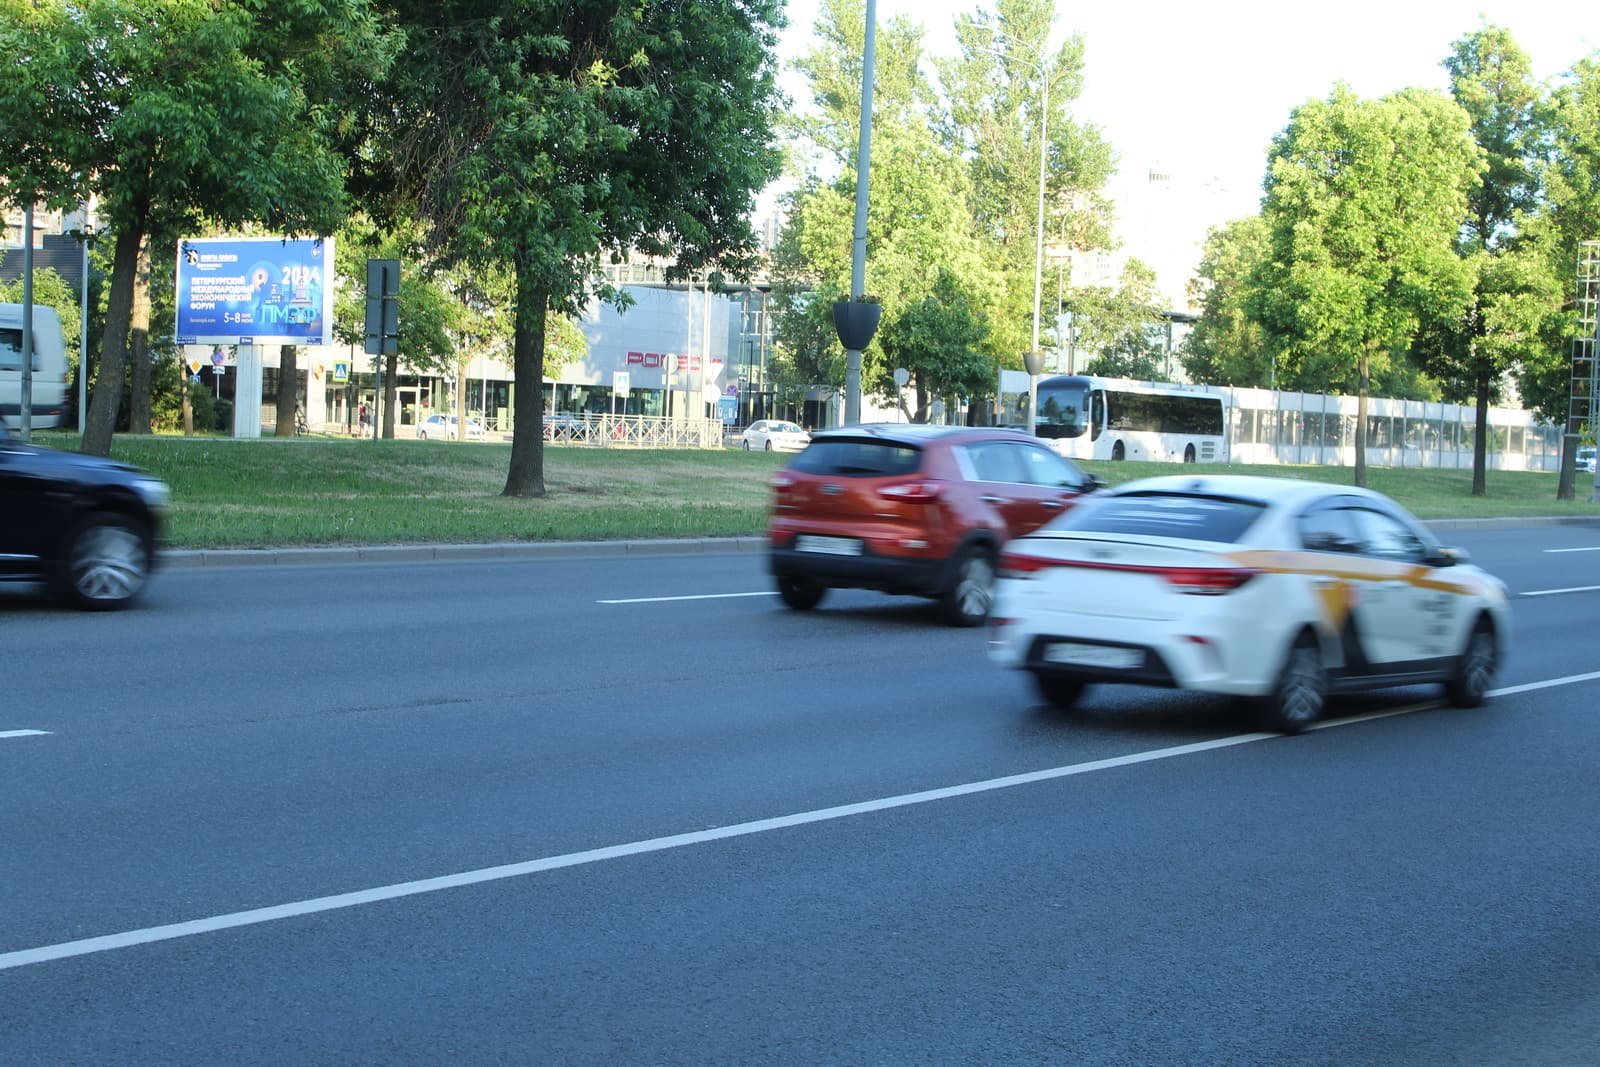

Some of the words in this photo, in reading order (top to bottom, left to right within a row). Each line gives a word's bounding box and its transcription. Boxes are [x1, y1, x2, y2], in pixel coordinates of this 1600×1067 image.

[191, 275, 246, 286] ПЕТЕРБУРГСКИЙ
[281, 266, 320, 285] 2024
[191, 284, 255, 294] МЕЖДУНАРОДНЫЙ
[190, 293, 252, 302] ЭКОНОМИЧЕСКИЙ
[190, 302, 215, 310] ФОРУМ
[262, 304, 317, 324] ПМЭФ
[626, 351, 722, 371] POSC
